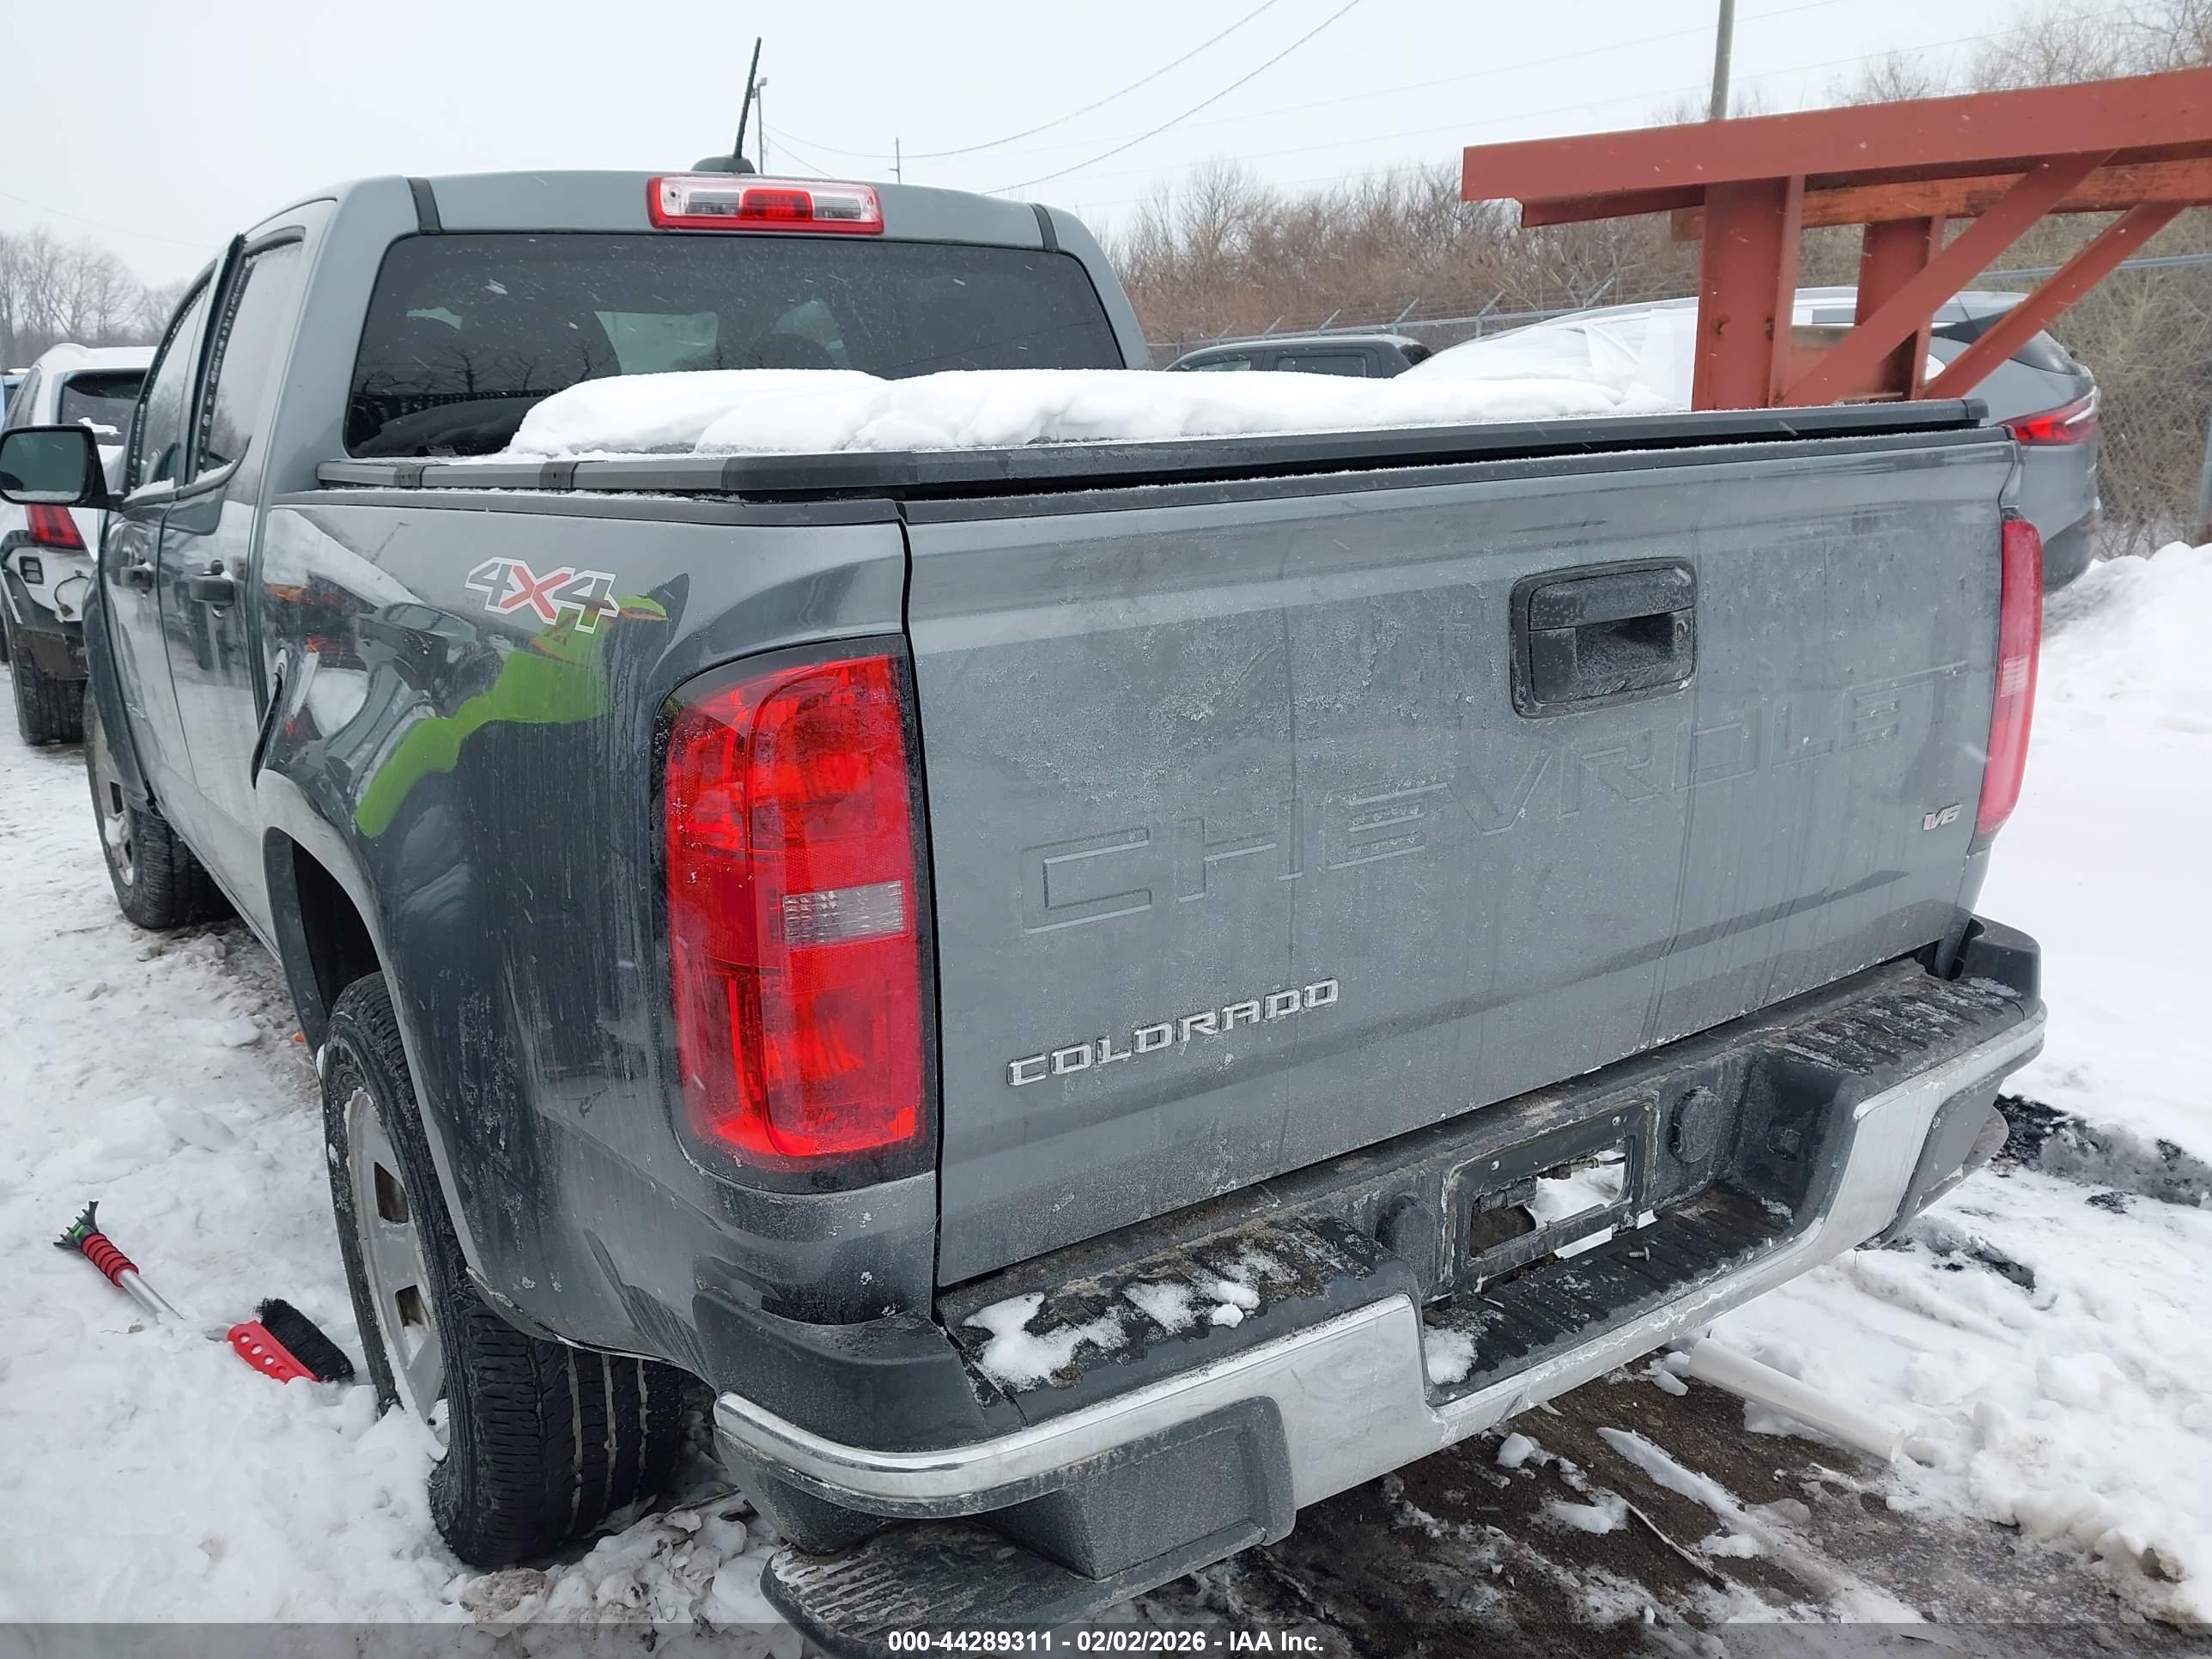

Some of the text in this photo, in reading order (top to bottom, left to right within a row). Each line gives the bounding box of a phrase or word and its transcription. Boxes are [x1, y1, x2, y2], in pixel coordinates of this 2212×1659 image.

[1020, 660, 1970, 934] CHEVROLET
[1923, 803, 1964, 831] V6
[1006, 976, 1339, 1086] COLORADO
